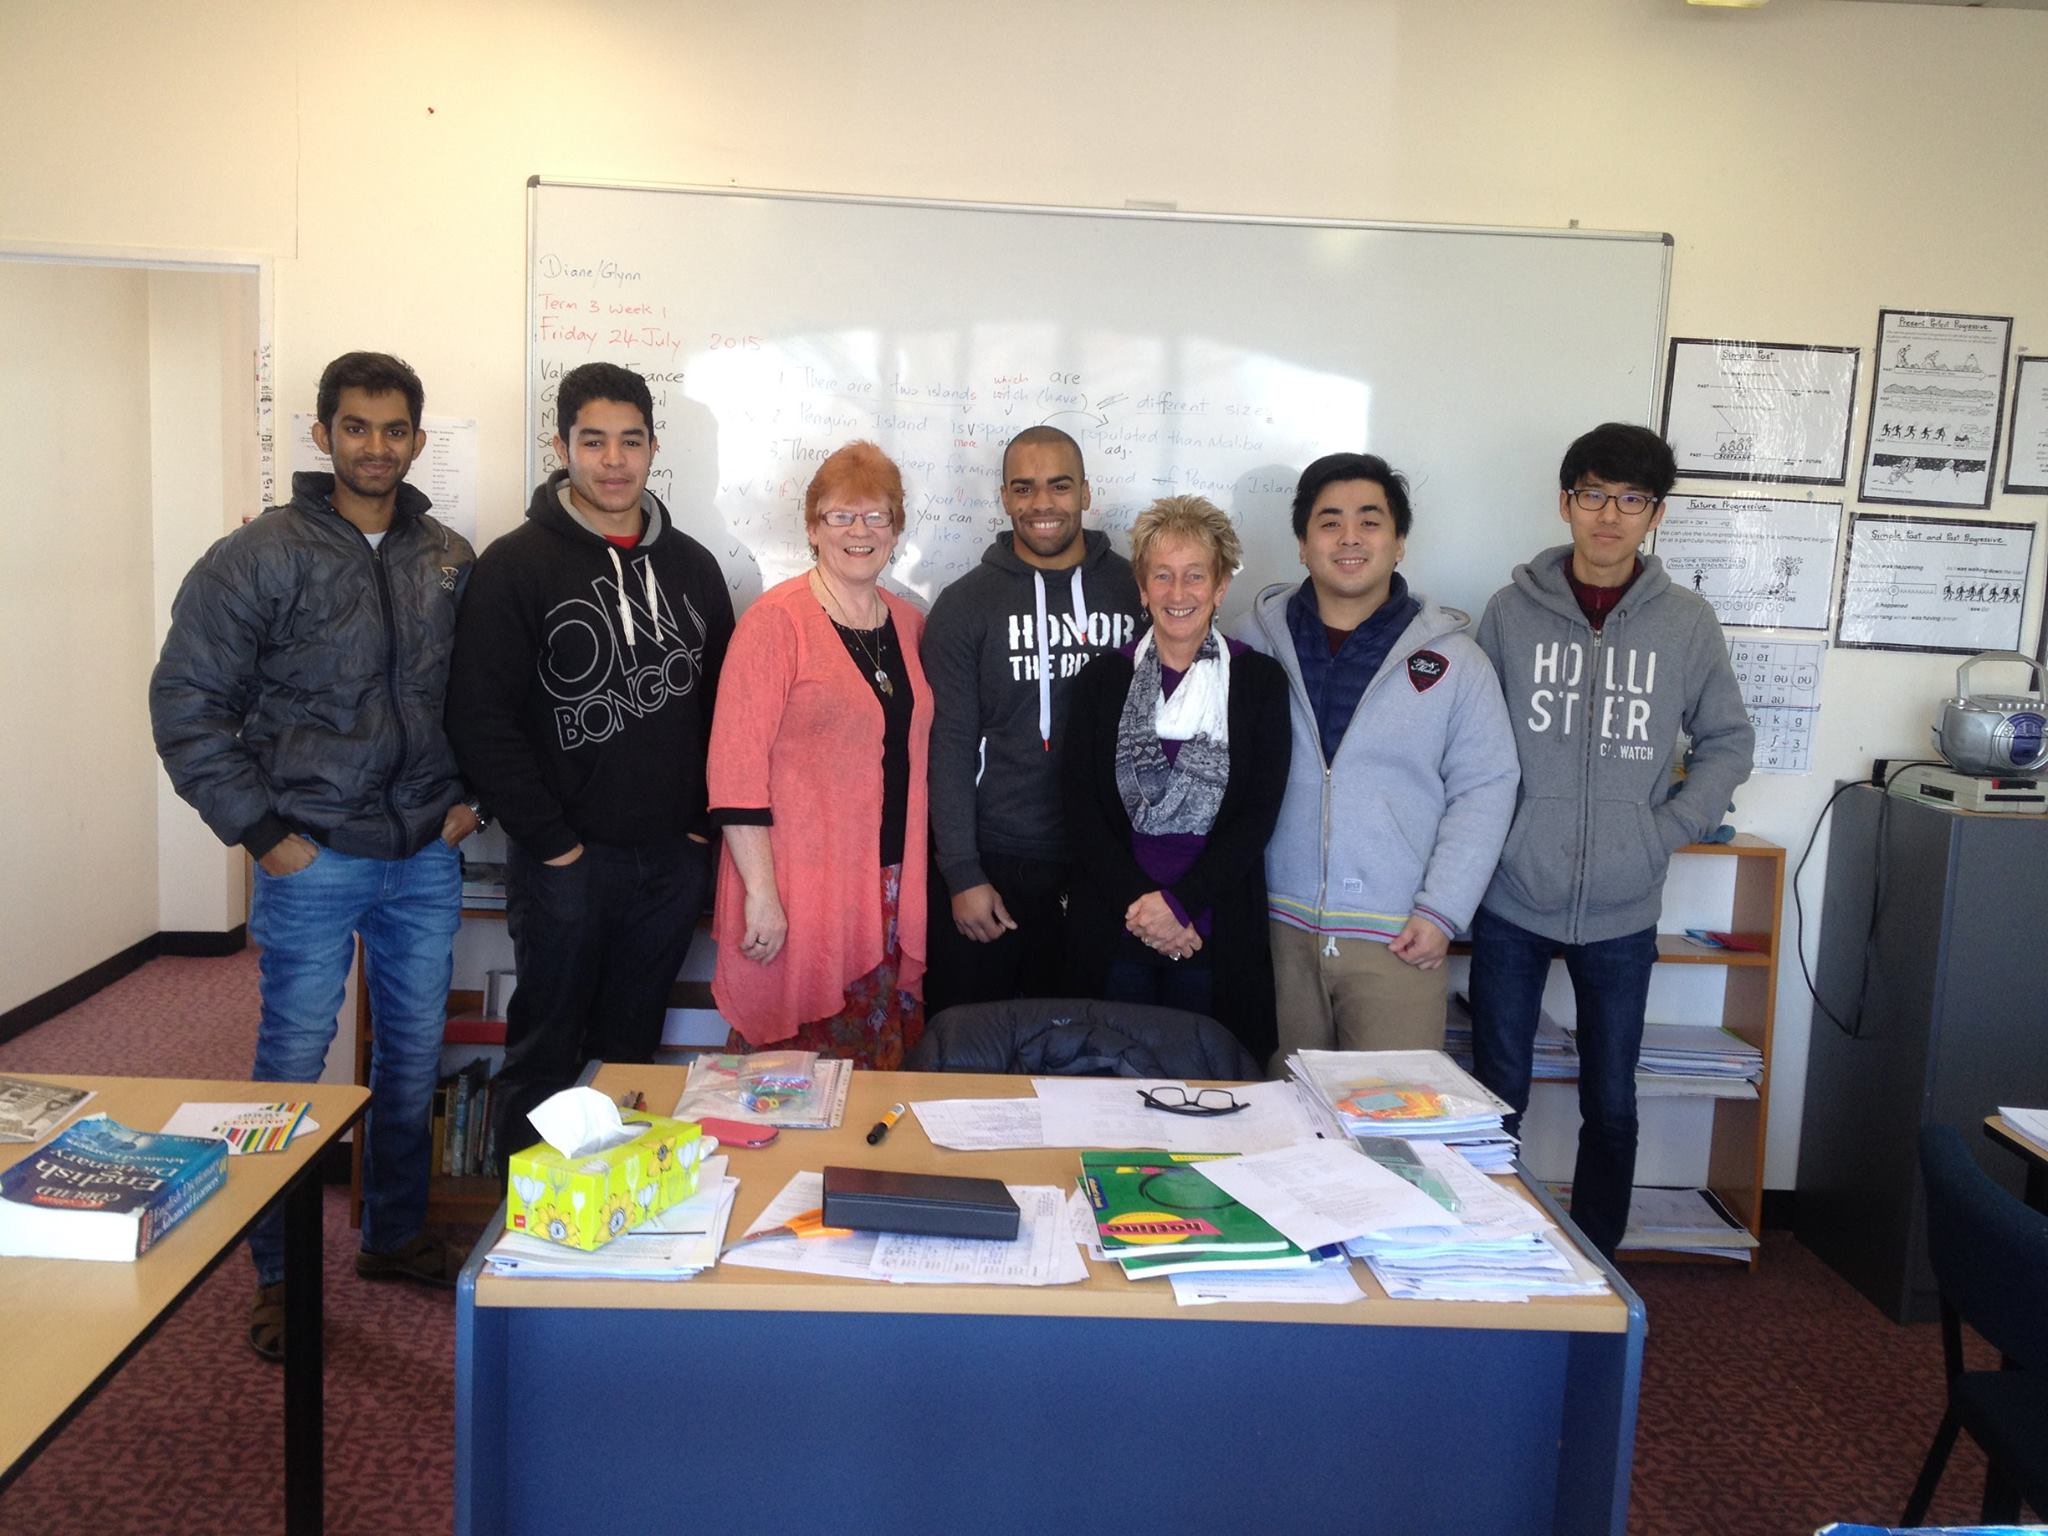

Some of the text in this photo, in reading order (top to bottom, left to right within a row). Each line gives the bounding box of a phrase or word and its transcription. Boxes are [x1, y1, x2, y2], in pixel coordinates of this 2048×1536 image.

[538, 293, 577, 312] Term
[588, 300, 600, 313] 3
[539, 315, 765, 361] Friday 24 July 2015
[1721, 350, 1752, 360] Simple
[796, 366, 838, 390] There
[847, 381, 872, 394] are
[1048, 371, 1082, 386] are
[800, 401, 858, 437] Penguin
[1688, 499, 1768, 512] Future Progressive
[917, 508, 941, 526] You
[948, 512, 973, 524] can
[1871, 530, 1901, 541] Simple
[1926, 533, 1942, 541] and
[1964, 534, 2005, 546] Progressive
[1008, 612, 1135, 650] HONOR
[1620, 745, 1654, 760] WATCH
[36, 1159, 165, 1192] English
[1106, 1221, 1204, 1234] hotline
